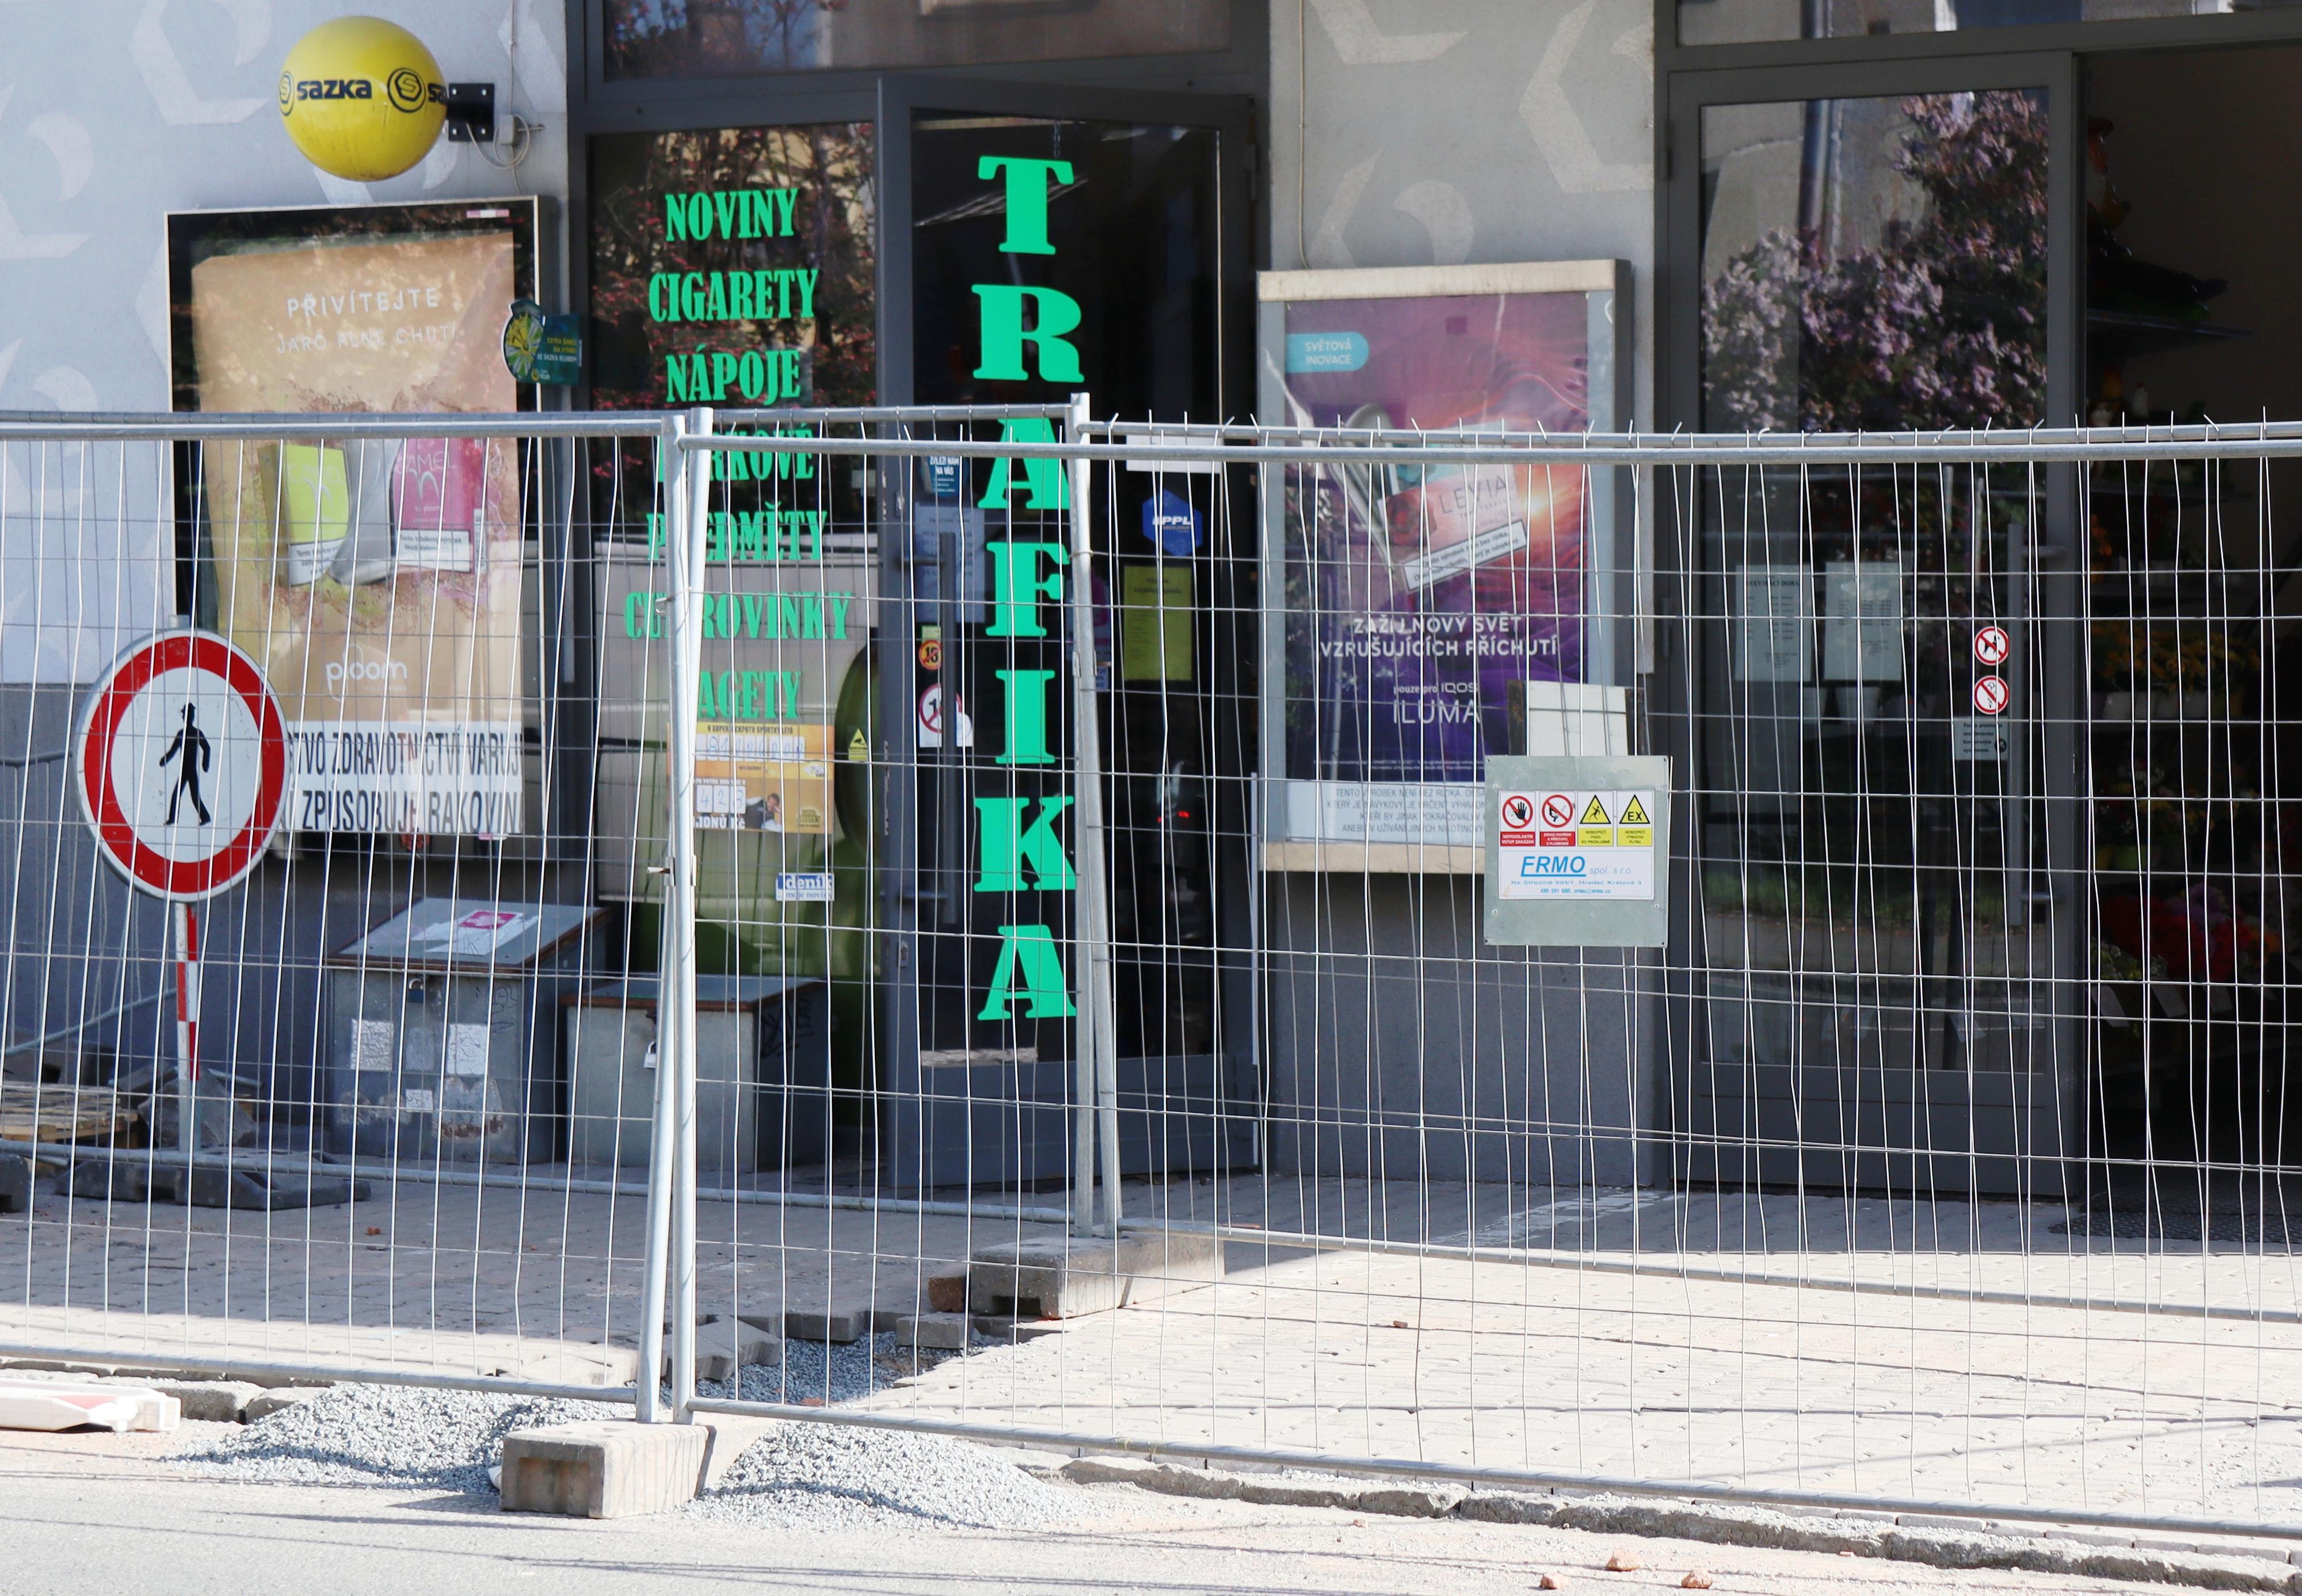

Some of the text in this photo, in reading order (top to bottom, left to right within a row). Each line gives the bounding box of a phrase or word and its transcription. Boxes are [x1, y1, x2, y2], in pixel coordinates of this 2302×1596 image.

[297, 79, 372, 100] sazka
[665, 188, 798, 242] NOVINY
[287, 288, 439, 318] PŘIVÍTEJTE
[649, 269, 818, 323] CIGARETY
[1305, 338, 1351, 352] SVĚTOVÁ
[1306, 354, 1351, 365] INOVACE
[666, 343, 801, 406] NÁPOJE
[658, 423, 814, 482] RKOVÉ
[646, 501, 828, 561] PDMĚTY
[971, 156, 1085, 1020] TRAFIKA
[625, 592, 854, 640] CUROVINKY
[698, 671, 801, 719] AGETY
[1393, 700, 1481, 724] ILUMA
[467, 731, 523, 777] VARUJ
[429, 791, 523, 833] RAKOVIN
[1628, 811, 1642, 821] EX
[1590, 866, 1609, 875] spol.
